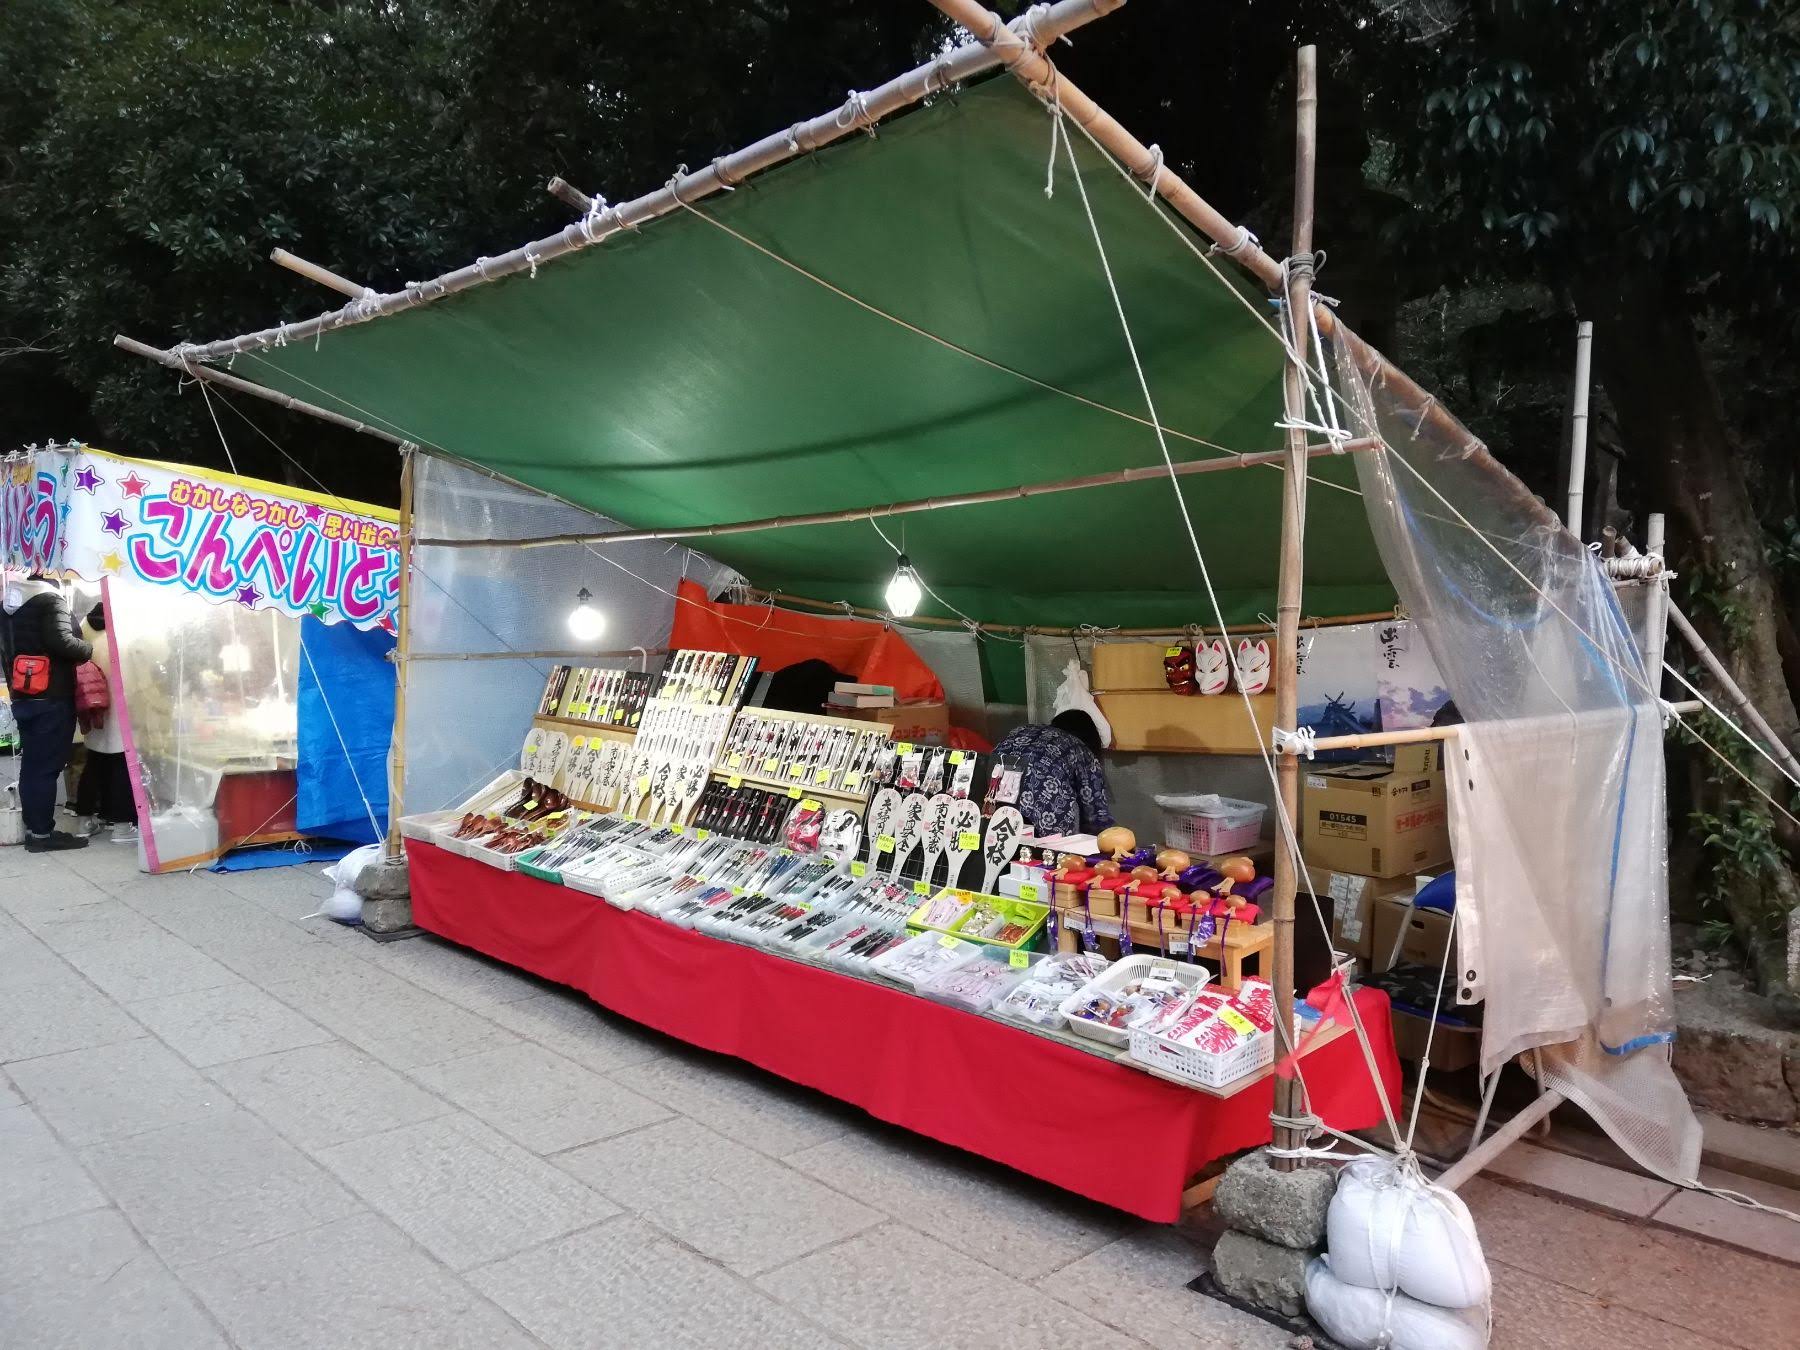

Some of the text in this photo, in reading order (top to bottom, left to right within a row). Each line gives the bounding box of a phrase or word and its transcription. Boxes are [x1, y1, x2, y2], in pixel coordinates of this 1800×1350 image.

[169, 479, 305, 529] むかしなつかし
[322, 513, 400, 550] 思い出の
[653, 762, 671, 799] 合格
[686, 765, 705, 798] 必勝
[897, 802, 922, 853] 家内安全
[985, 816, 1017, 867] 合格
